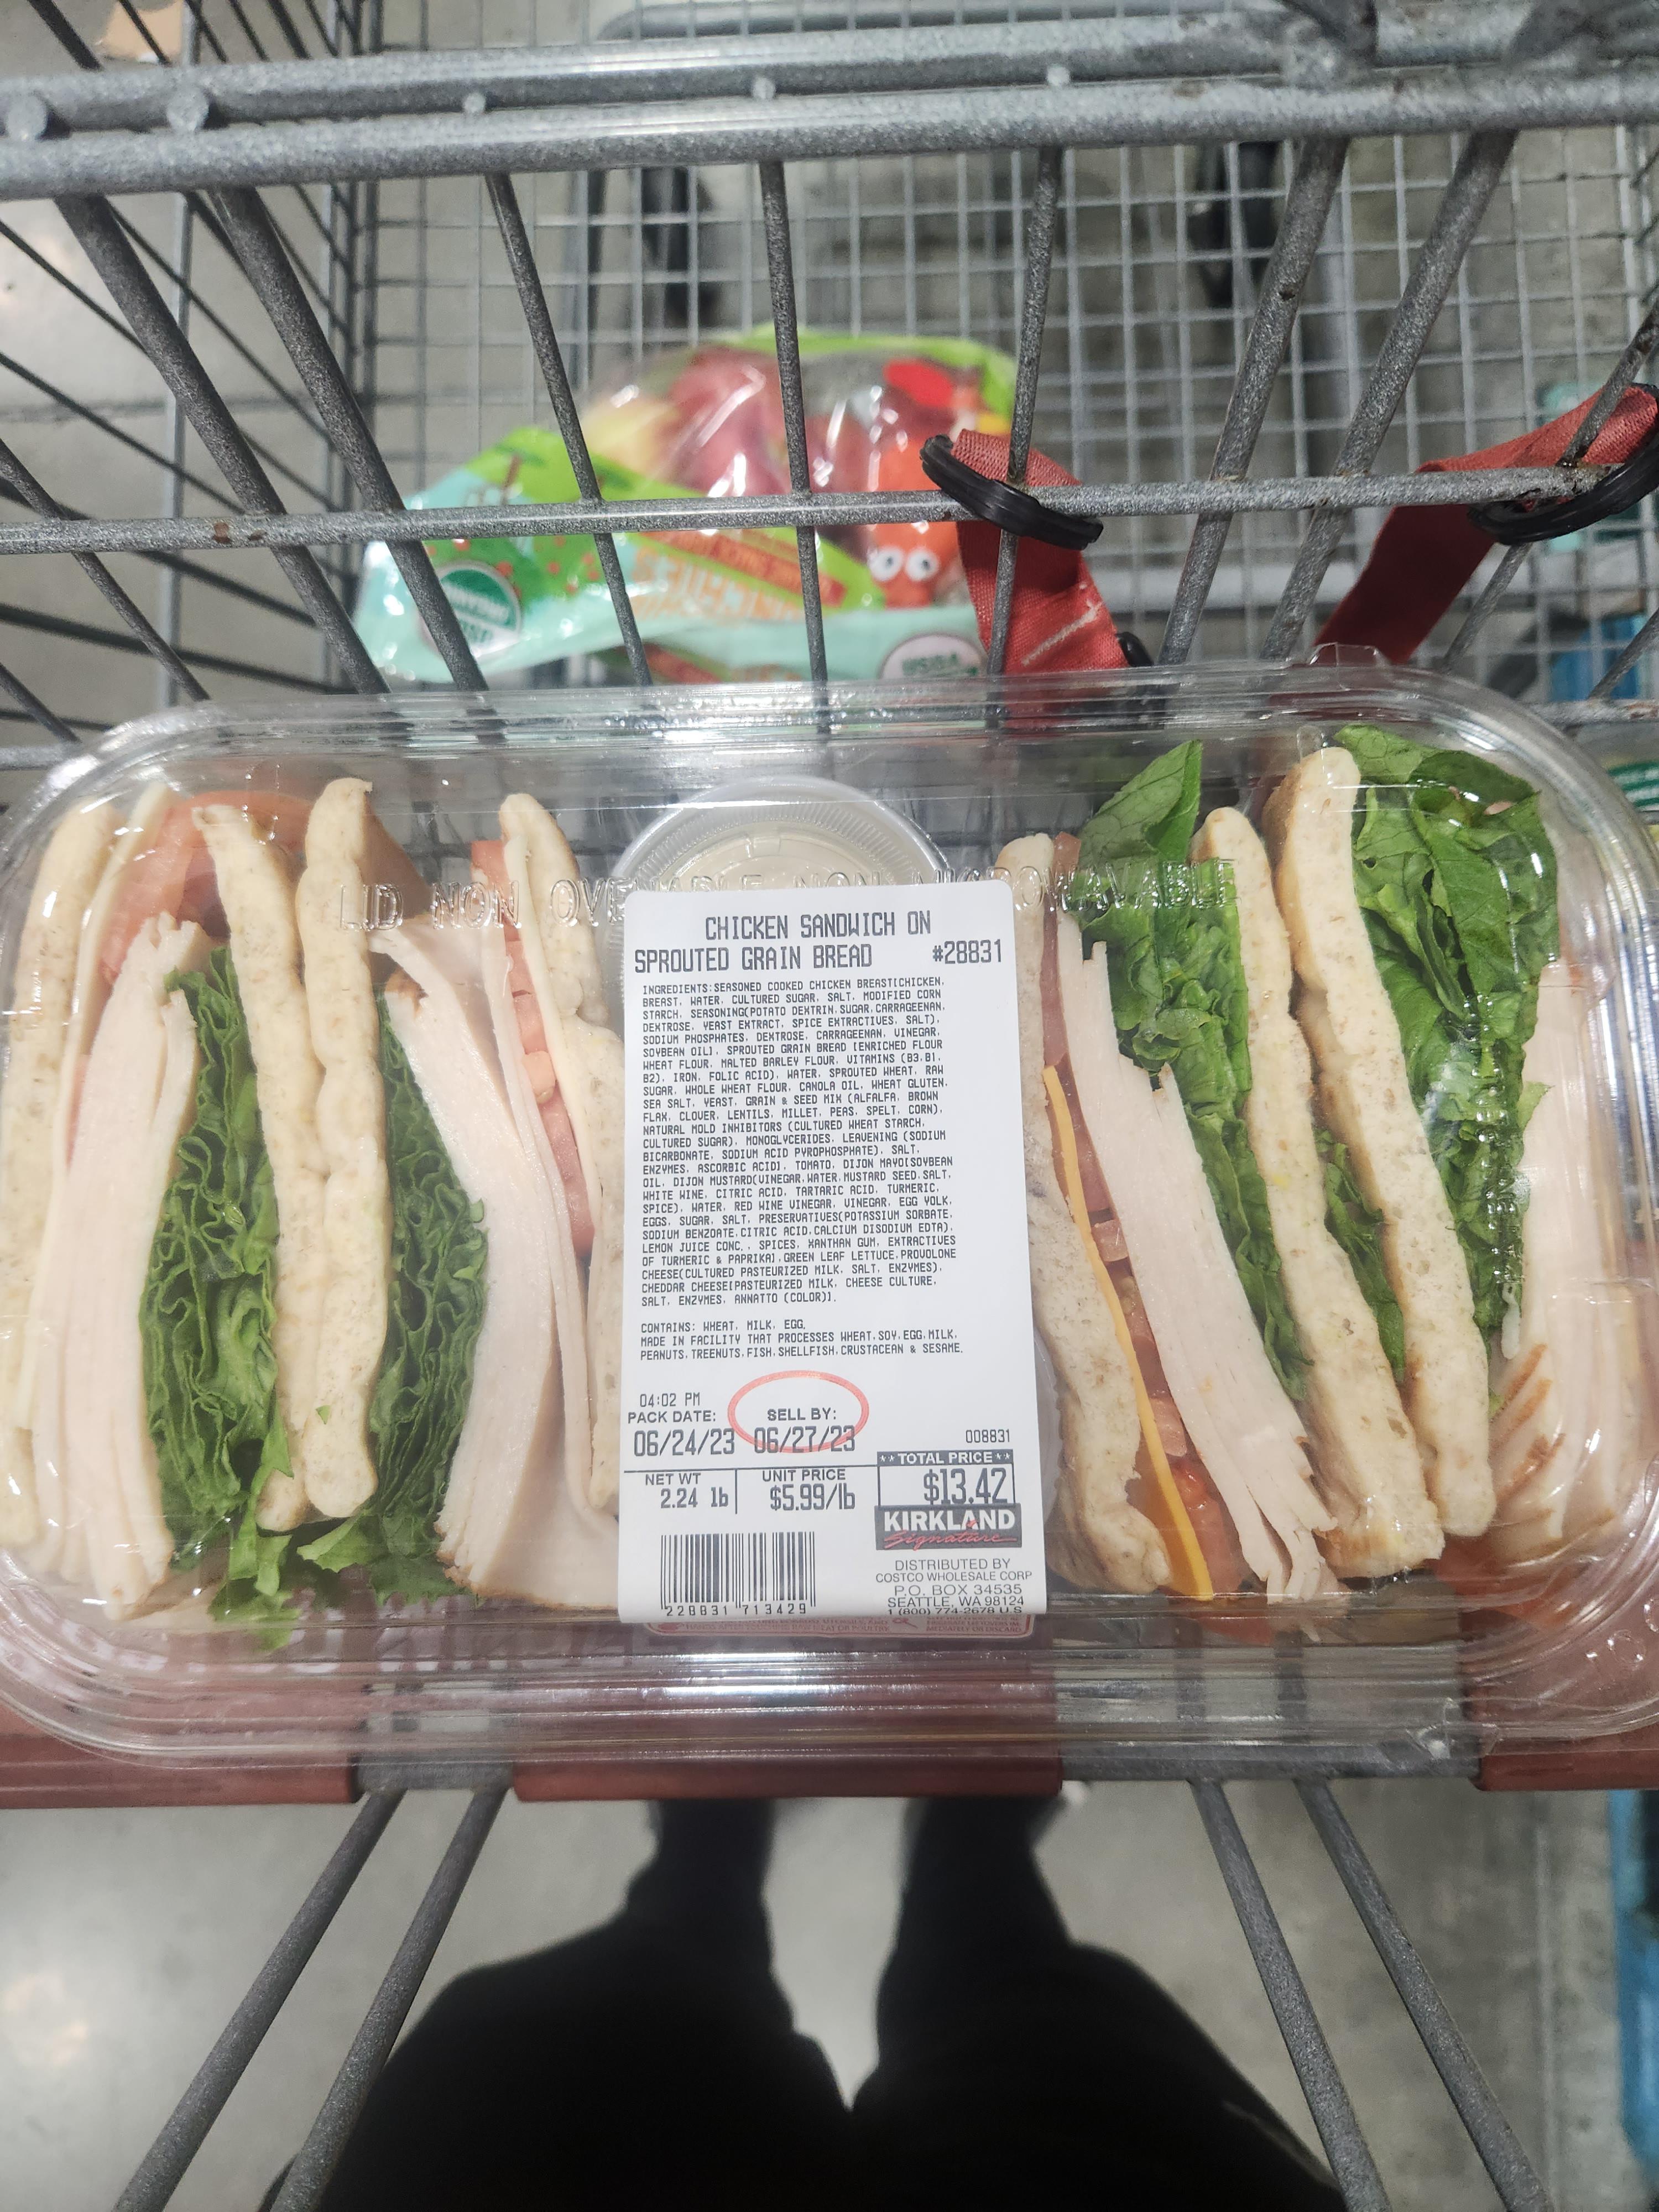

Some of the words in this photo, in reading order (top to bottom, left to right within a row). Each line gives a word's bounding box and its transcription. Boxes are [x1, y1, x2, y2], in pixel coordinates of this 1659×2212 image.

[706, 915, 788, 940] CHICKEN
[801, 912, 895, 938] SANDWICH
[907, 910, 931, 935] ON
[635, 947, 729, 973] SPROUTED
[742, 946, 800, 970] GRAIN
[813, 943, 872, 968] BREAD
[932, 939, 1001, 964] #28831
[768, 981, 803, 991] COOKED
[810, 979, 851, 989] CHICKEN
[732, 994, 779, 1004] CULTURED
[864, 990, 910, 1001] MODIFIED
[917, 989, 941, 999] CORN
[703, 1020, 732, 1030] YEAST
[792, 1018, 822, 1027] SPICE
[643, 1035, 678, 1045] SODIUM
[709, 1071, 738, 1081] FOLIC
[830, 1067, 877, 1077] SPROUTED
[926, 1065, 943, 1074] RAW
[686, 1085, 714, 1094] WHOLE
[722, 1084, 751, 1093] WHEAT
[800, 1081, 835, 1092] CANOLA
[872, 1079, 901, 1089] WHEAT
[644, 1099, 660, 1109] SEA
[746, 1095, 775, 1106] GRAIN
[794, 1094, 817, 1104] SEED
[824, 1094, 841, 1104] MIX
[909, 1091, 938, 1101] BROWN
[644, 1125, 685, 1135] NATURAL
[692, 1124, 715, 1134] MOLD
[723, 1122, 781, 1133] INHIBITORS
[849, 1119, 878, 1129] WHEAT
[722, 1149, 758, 1159] SODIUM
[765, 1148, 788, 1158] ACID
[643, 1191, 673, 1201] WHITE
[717, 1188, 752, 1198] CITRIC
[796, 1186, 843, 1196] TARTARIC
[735, 1201, 752, 1211] RED
[759, 1200, 782, 1210] WINE
[899, 1197, 917, 1206] EGG
[643, 1243, 672, 1253] LEMON
[680, 1242, 709, 1252] JUICE
[808, 1238, 851, 1249] XANTHAN
[889, 1235, 955, 1246] EXTRACTIVES
[735, 1293, 777, 1304] ANNATTO
[641, 1322, 695, 1333] CONTAINS:
[641, 1337, 665, 1347] MADE
[673, 1336, 684, 1346] IN
[691, 1334, 740, 1345] FACILITY
[748, 1334, 771, 1344] THAT
[779, 1332, 834, 1343] PROCESSES
[640, 1393, 676, 1407] 04:02
[685, 1392, 700, 1406] PM
[628, 1411, 667, 1424] PACK
[673, 1410, 716, 1422] DATE:
[768, 1408, 806, 1421] SELL
[811, 1407, 836, 1420] BY:
[634, 1428, 734, 1457] 06/24/23
[754, 1425, 855, 1453] 06/27/23
[966, 1429, 1010, 1443] 008831
[898, 1453, 945, 1464] TOTAL
[948, 1452, 993, 1464] PRICE
[645, 1473, 674, 1485] NET
[679, 1473, 701, 1485] WT
[763, 1469, 796, 1481] UNIT
[802, 1468, 846, 1481] PRICE
[924, 1467, 1008, 1505] $13.42
[660, 1488, 698, 1509] 2.24
[711, 1486, 729, 1507] lb
[770, 1483, 855, 1511] $5.99/lb
[884, 1510, 1015, 1532] KIRKLAND
[884, 1530, 1017, 1551] Signature
[895, 1558, 988, 1571] DISTRIBUTED
[993, 1558, 1011, 1569] BY
[876, 1572, 924, 1583] COSTCO
[927, 1571, 996, 1582] WHOLESALE
[894, 1585, 925, 1597] P.O.
[932, 1584, 968, 1595] BOX
[974, 1584, 1022, 1594] 34535
[742, 1603, 806, 1615] 713429
[888, 1597, 954, 1608] SEATTLE,
[958, 1597, 981, 1606] WA
[985, 1596, 1024, 1606] 98124
[898, 1608, 931, 1616] (800)
